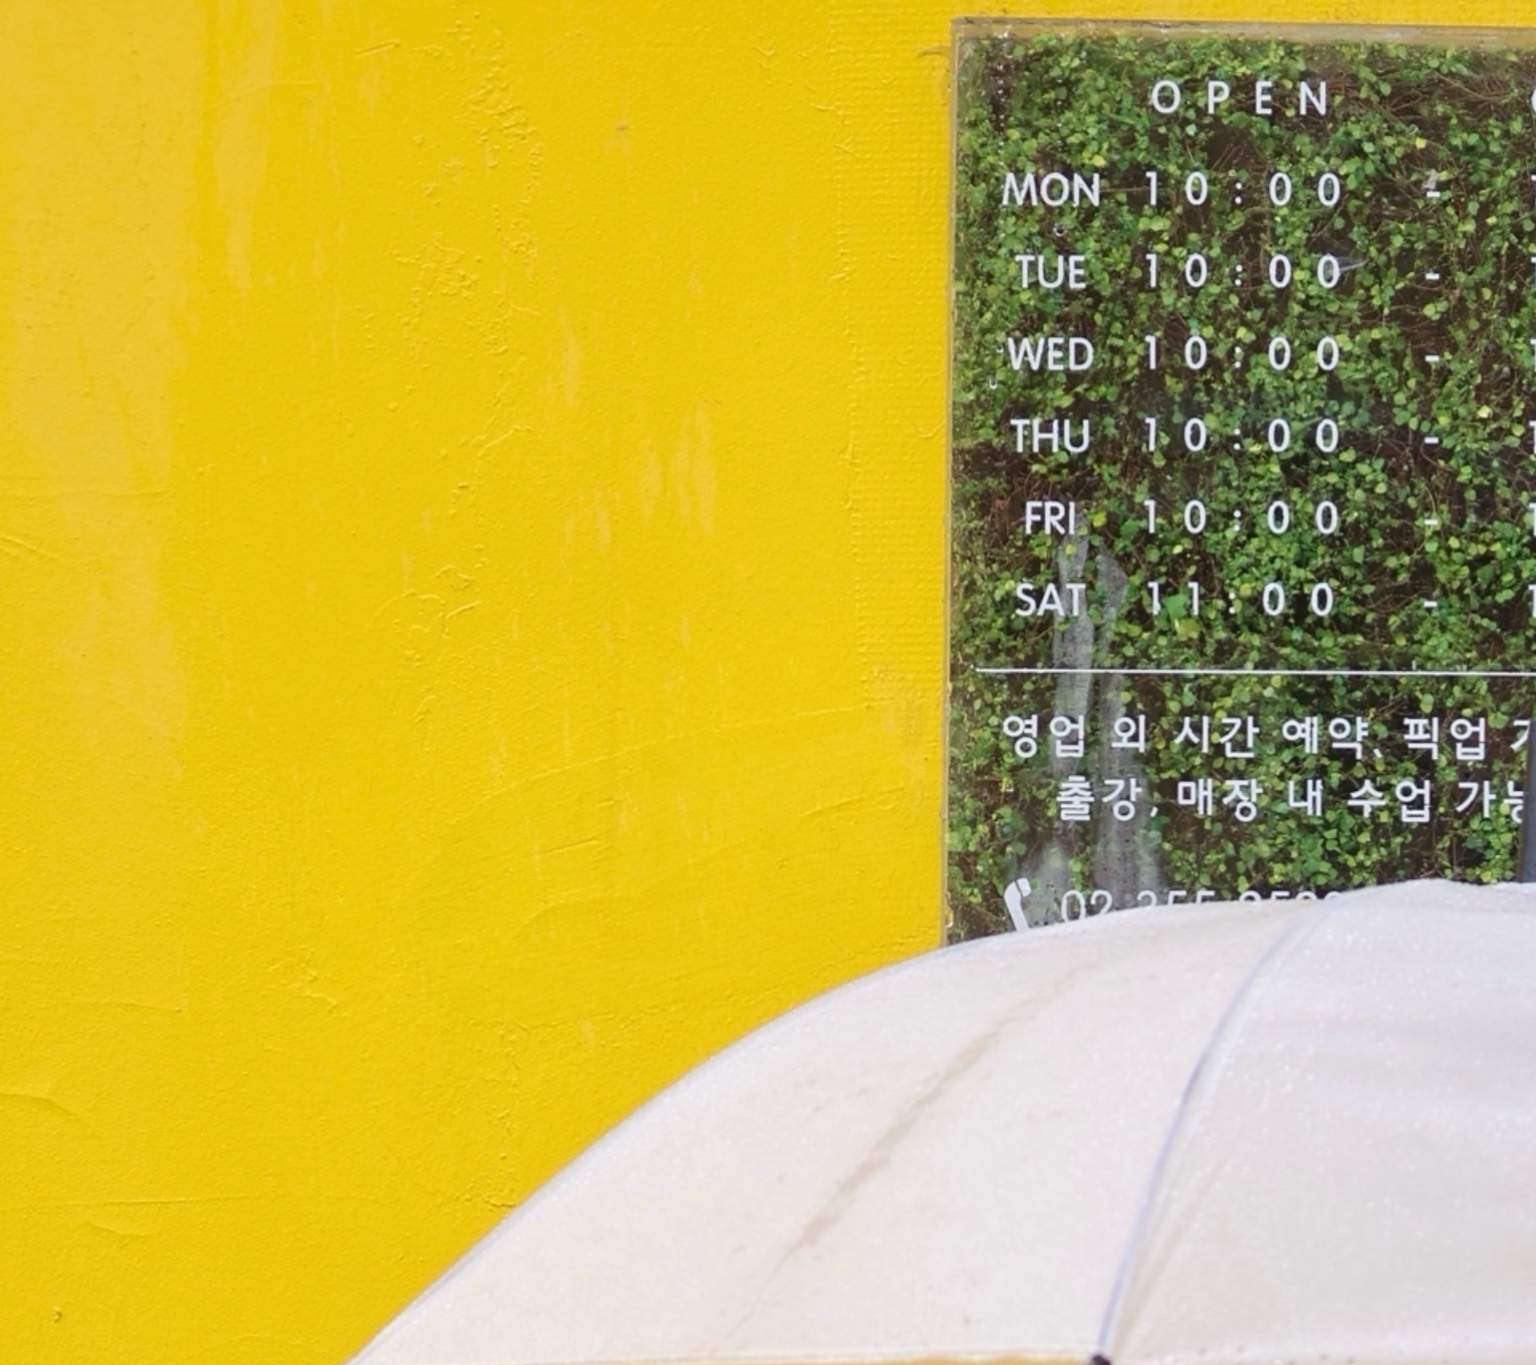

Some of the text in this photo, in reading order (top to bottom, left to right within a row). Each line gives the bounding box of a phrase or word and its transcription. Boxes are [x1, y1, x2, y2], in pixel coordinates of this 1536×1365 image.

[1151, 79, 1327, 115] OPEN
[1002, 172, 1100, 207] MON
[1145, 171, 1340, 207] 10:00
[1015, 254, 1086, 289] TUE
[1146, 253, 1341, 289] 10:00
[1007, 337, 1094, 371] WED
[1145, 335, 1339, 371] 10:00
[1010, 418, 1089, 453] THU
[1145, 417, 1339, 453] 10:00
[1025, 501, 1075, 535] FRI
[1144, 499, 1339, 534] 10:00
[1015, 582, 1086, 617] SAT
[1148, 581, 1333, 616] 11:00
[1003, 714, 1085, 759] 영업
[1111, 714, 1146, 753] 외
[1174, 715, 1260, 758] 시간
[1403, 717, 1485, 761] 픽업
[1056, 775, 1158, 822] 출강,
[1177, 778, 1263, 822] 매장
[1288, 779, 1323, 817] 내
[1347, 779, 1430, 823] 수업
